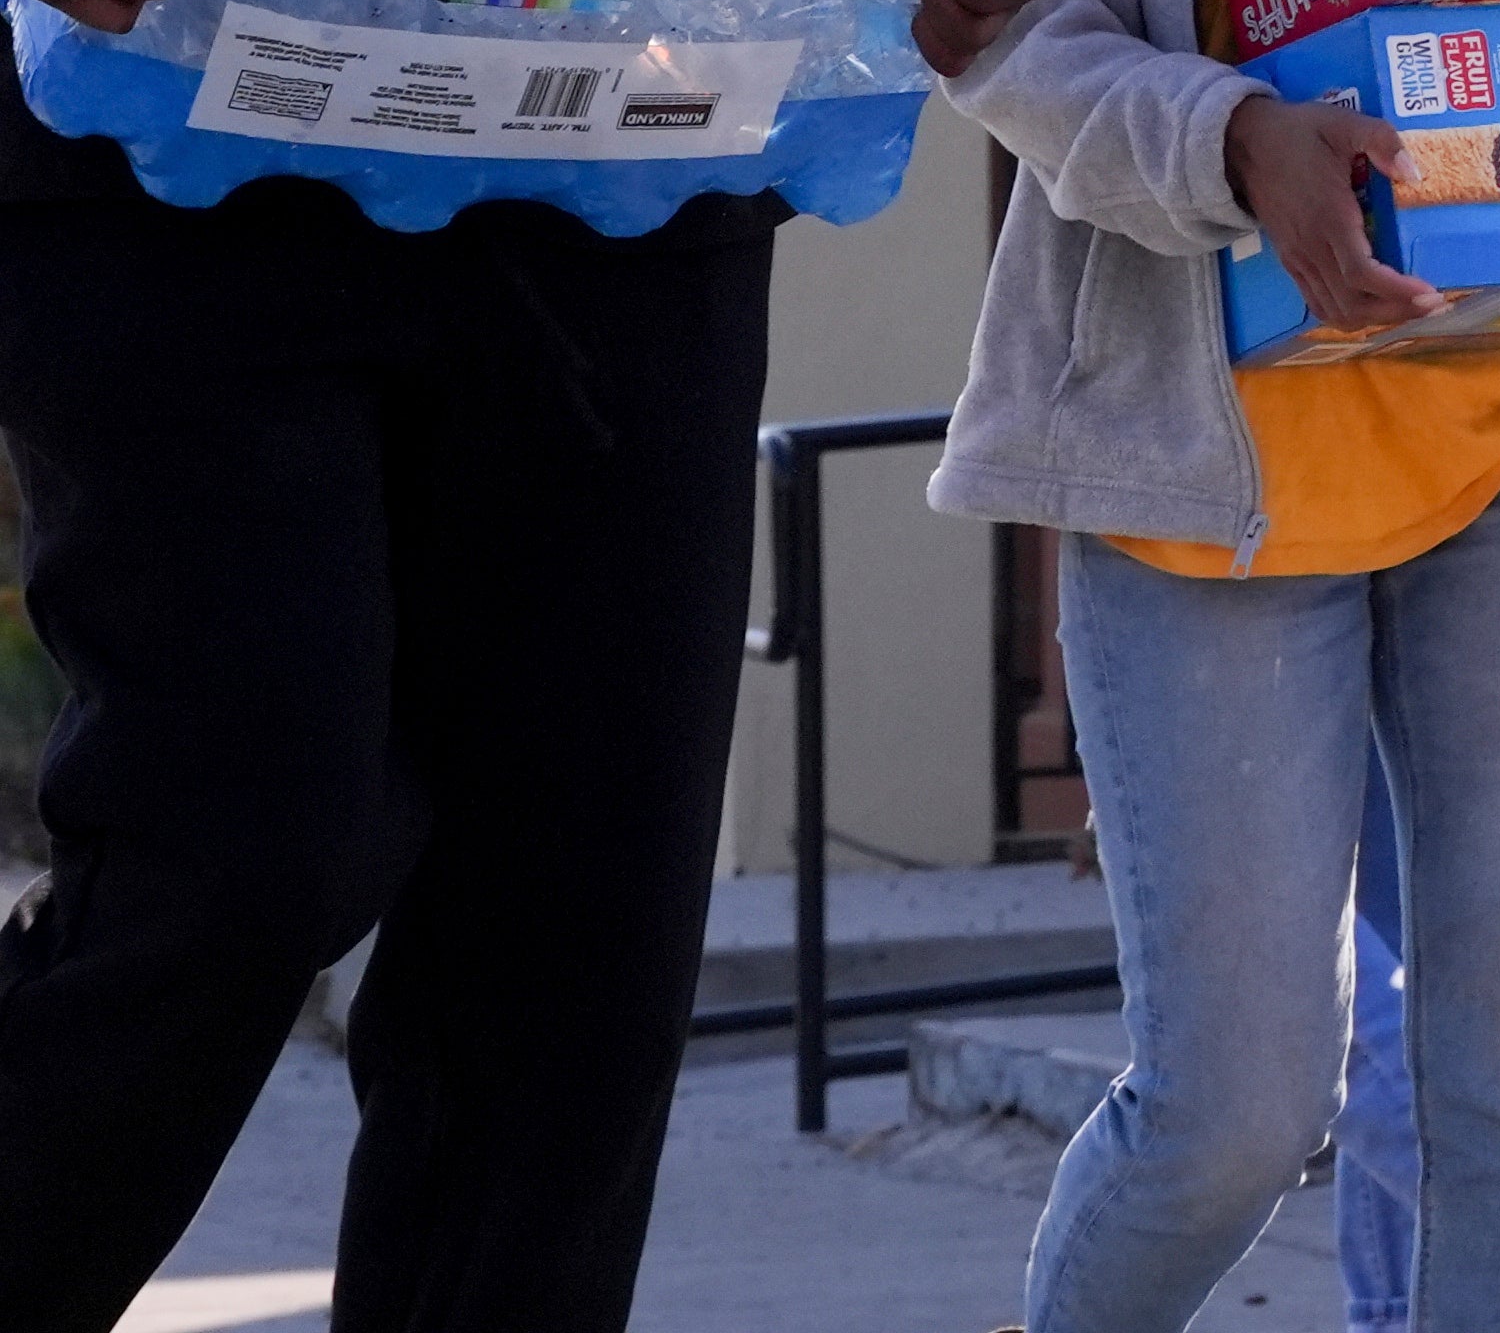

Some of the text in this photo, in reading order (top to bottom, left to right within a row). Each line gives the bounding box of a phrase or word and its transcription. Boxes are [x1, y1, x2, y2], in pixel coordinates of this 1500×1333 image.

[1396, 42, 1424, 112] GRAINS
[1412, 38, 1440, 108] WHOLE
[1444, 38, 1468, 106] FLAVOR
[1462, 35, 1493, 107] FRUIT
[625, 113, 705, 125] KIRKLAND
